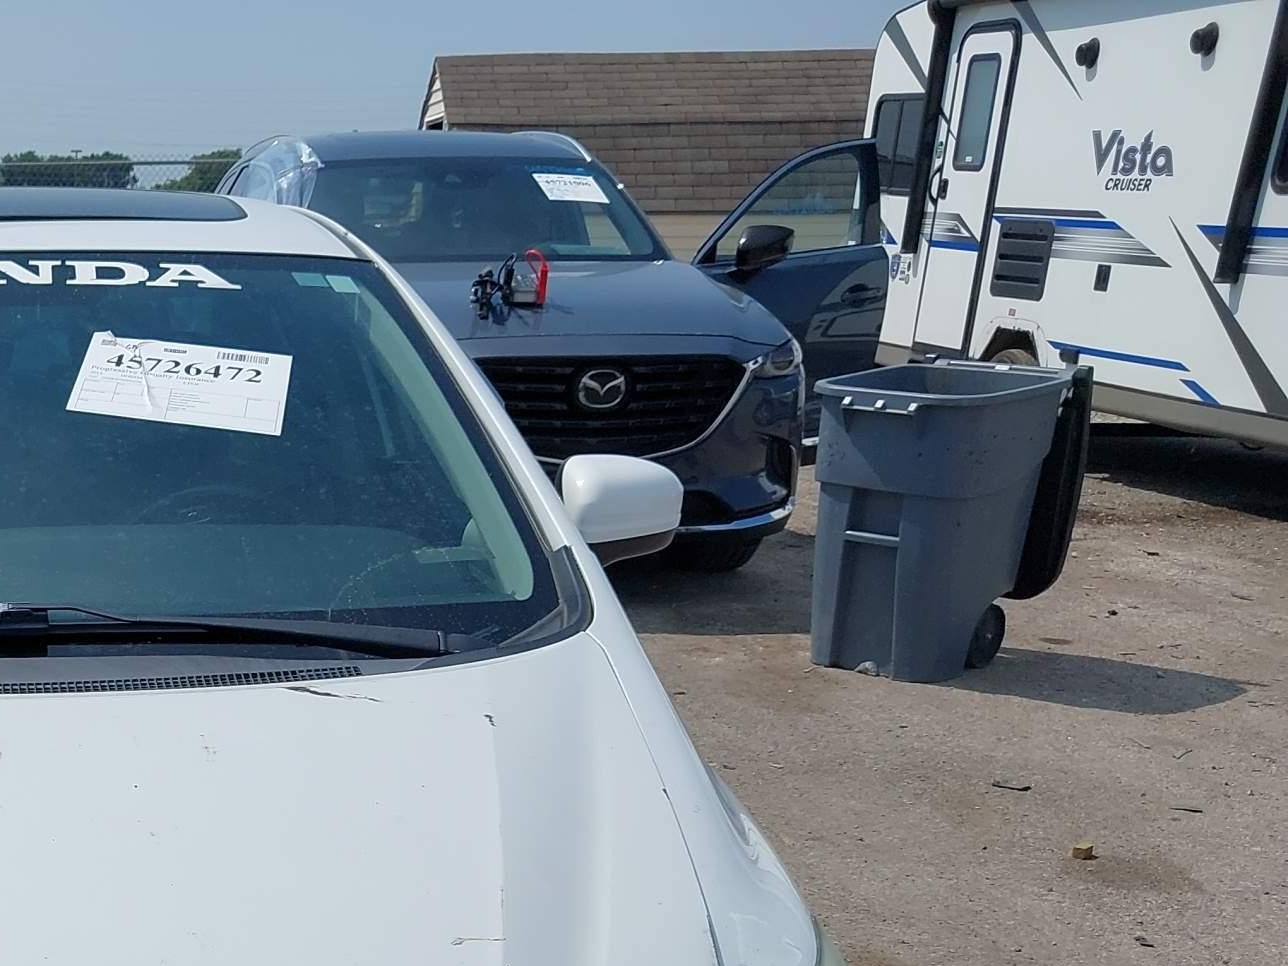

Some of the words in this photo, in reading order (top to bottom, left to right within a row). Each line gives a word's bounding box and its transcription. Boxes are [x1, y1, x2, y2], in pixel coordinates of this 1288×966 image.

[1092, 129, 1174, 177] Vista
[1104, 177, 1153, 192] CRUISER
[106, 353, 263, 384] 45726472
